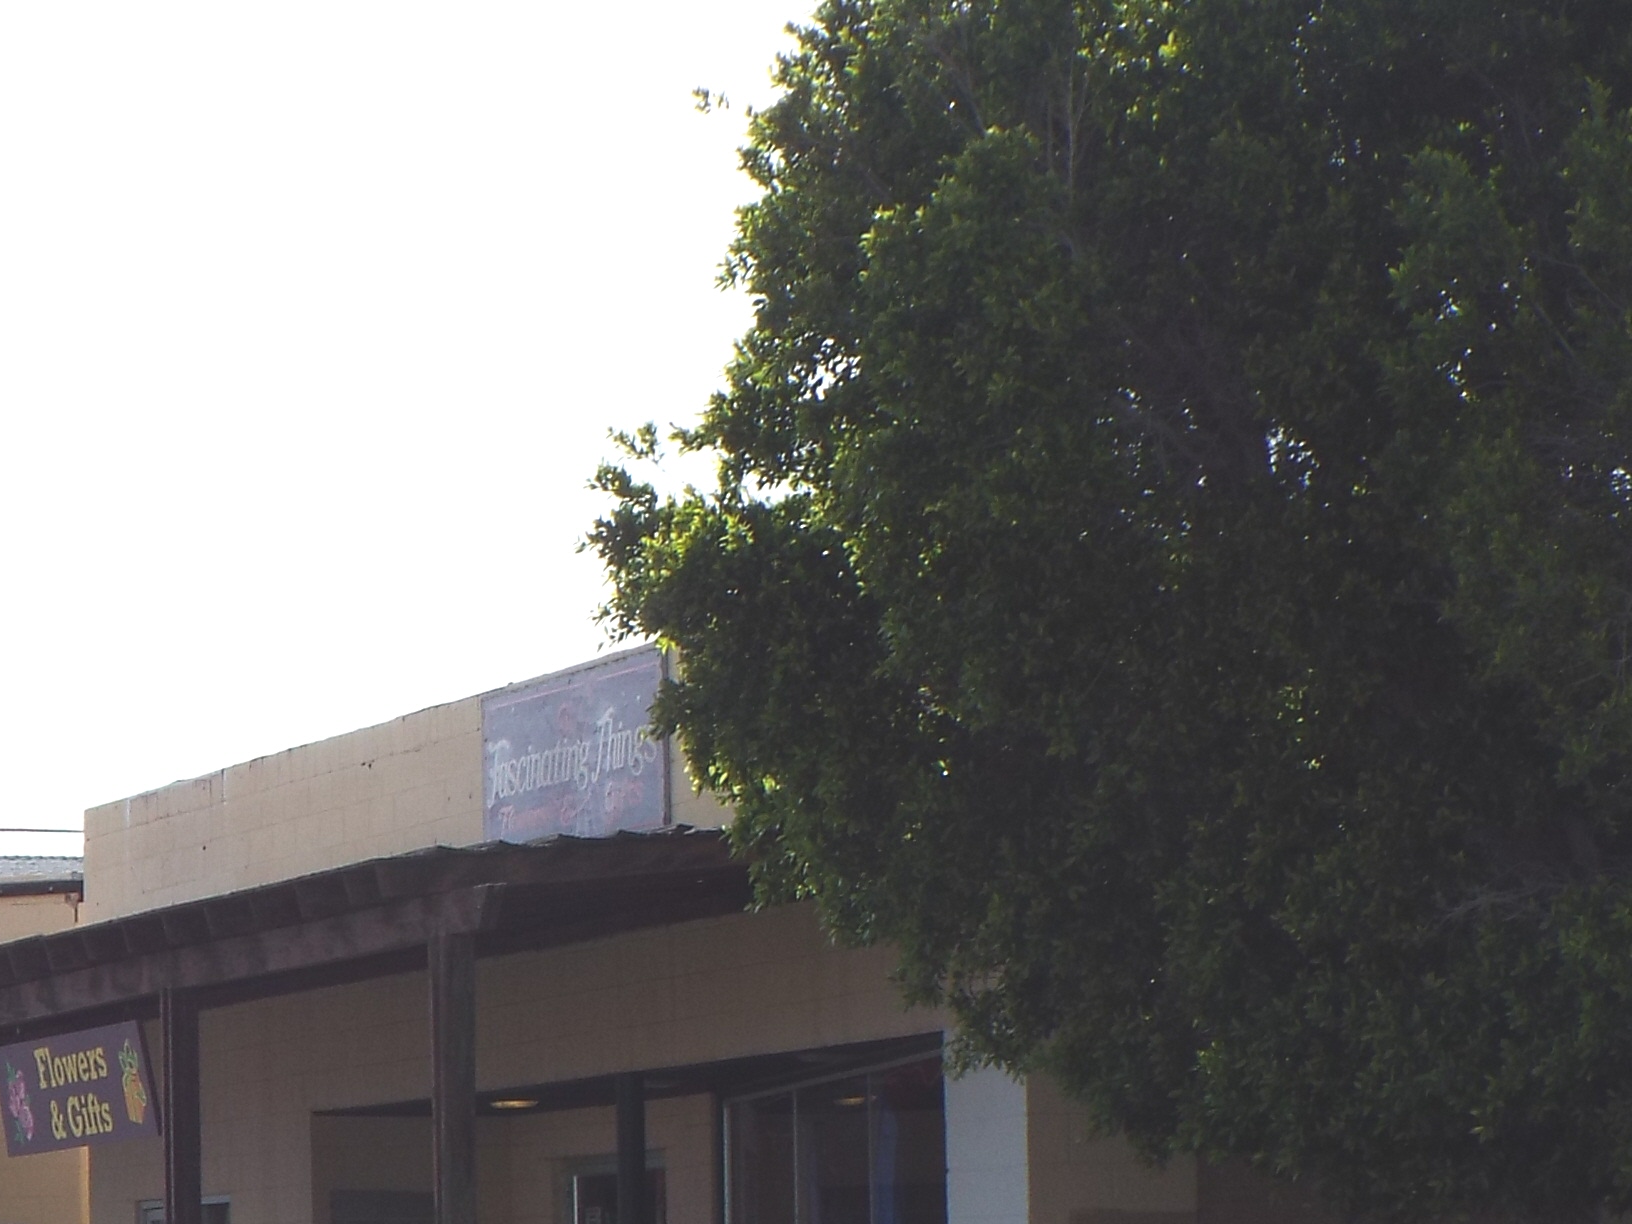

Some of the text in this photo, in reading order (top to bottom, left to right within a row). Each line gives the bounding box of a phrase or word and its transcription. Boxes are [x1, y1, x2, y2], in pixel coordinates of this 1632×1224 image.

[487, 739, 589, 808] Fascinating
[33, 1047, 108, 1090] Flowers
[50, 1093, 113, 1140] & Gifts
